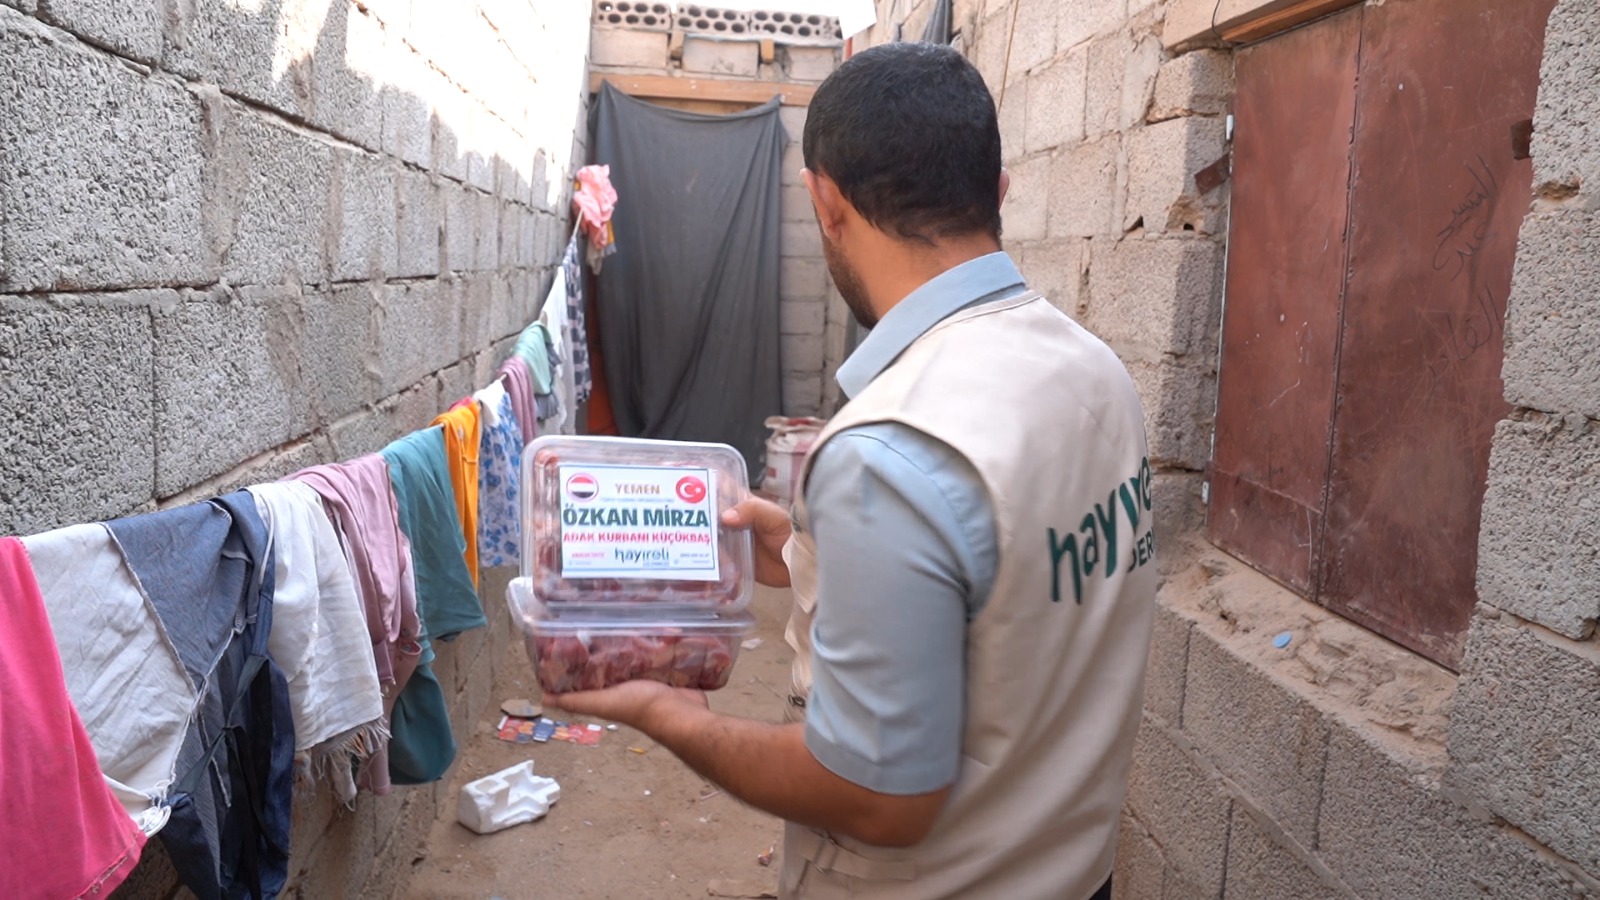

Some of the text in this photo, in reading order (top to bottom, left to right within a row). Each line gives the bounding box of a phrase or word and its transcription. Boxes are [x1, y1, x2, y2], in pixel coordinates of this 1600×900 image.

[615, 483, 661, 495] YEMEN
[563, 503, 710, 527] ÖZKAN MİRZA
[563, 532, 711, 545] ADAK KURBANI KÜÇÜKBAŞ
